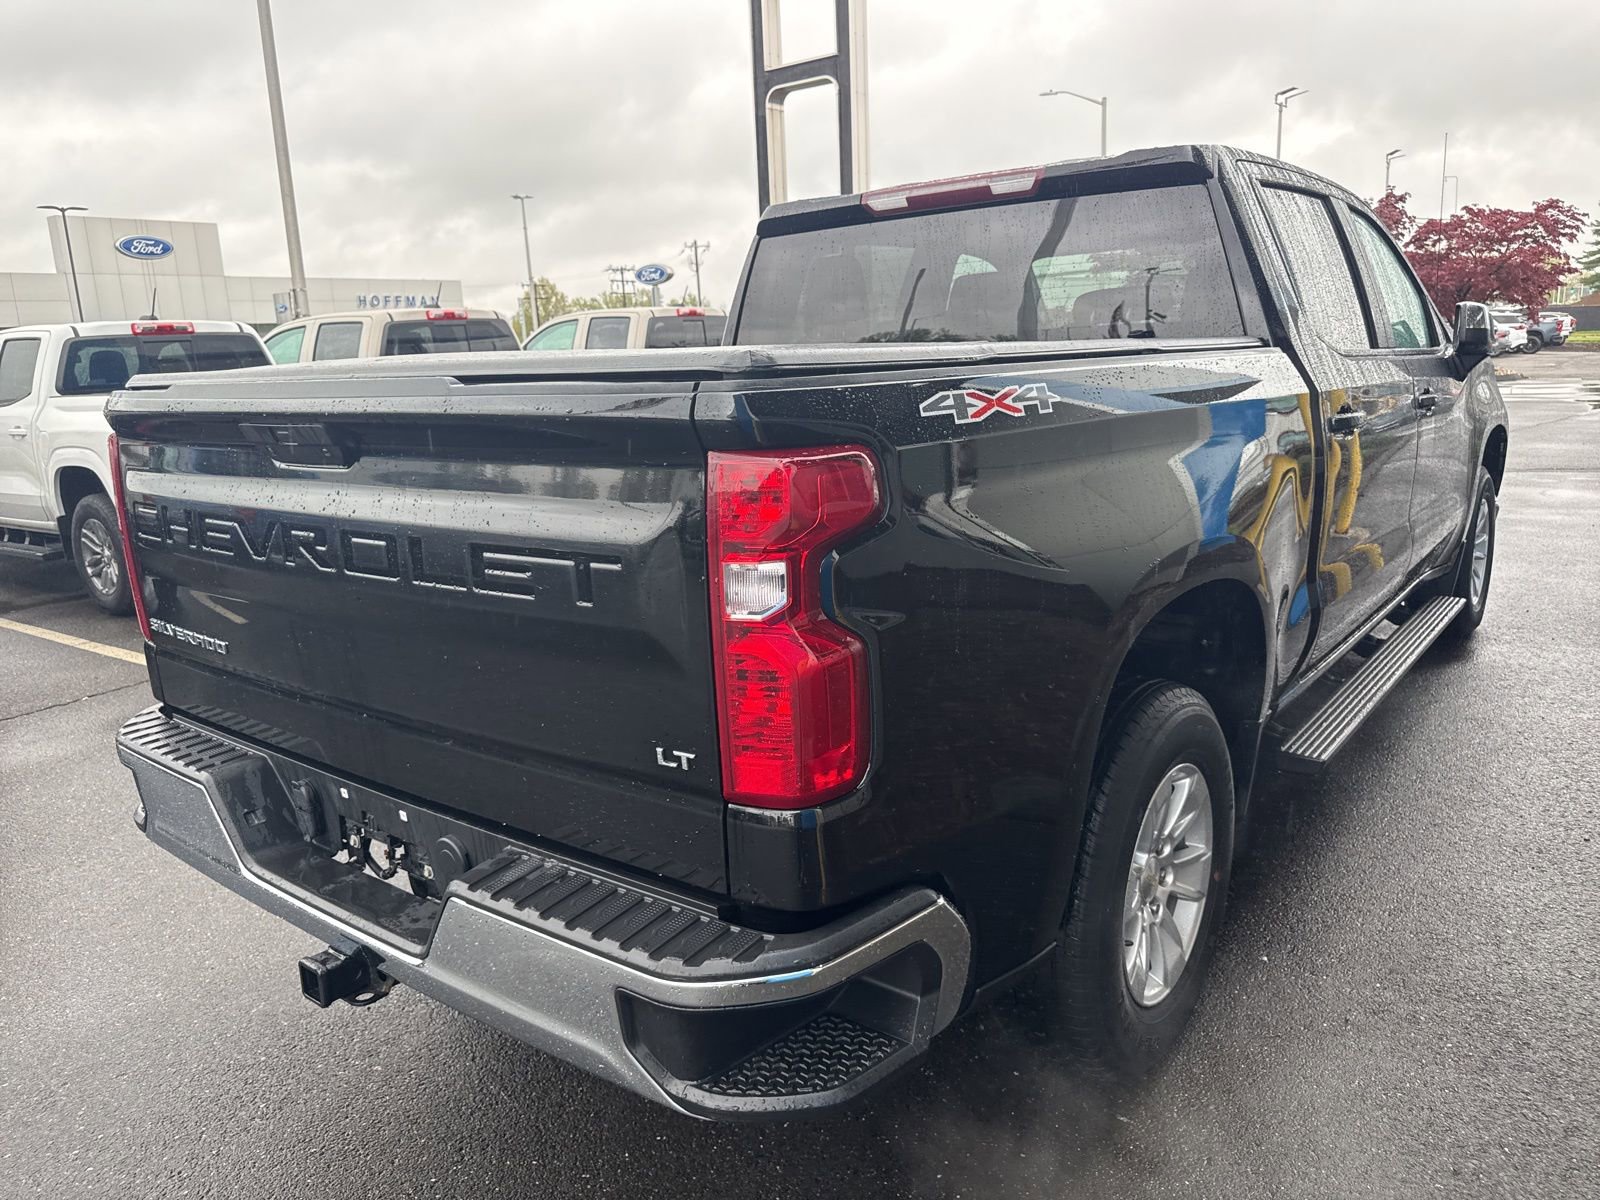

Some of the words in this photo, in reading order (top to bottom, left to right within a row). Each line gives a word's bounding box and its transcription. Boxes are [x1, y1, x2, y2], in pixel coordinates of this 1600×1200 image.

[130, 239, 164, 254] Ford
[358, 295, 440, 308] HOFFMAN
[133, 501, 622, 608] CHEVROLET
[149, 617, 229, 655] SILVERADO
[655, 746, 696, 771] LT
